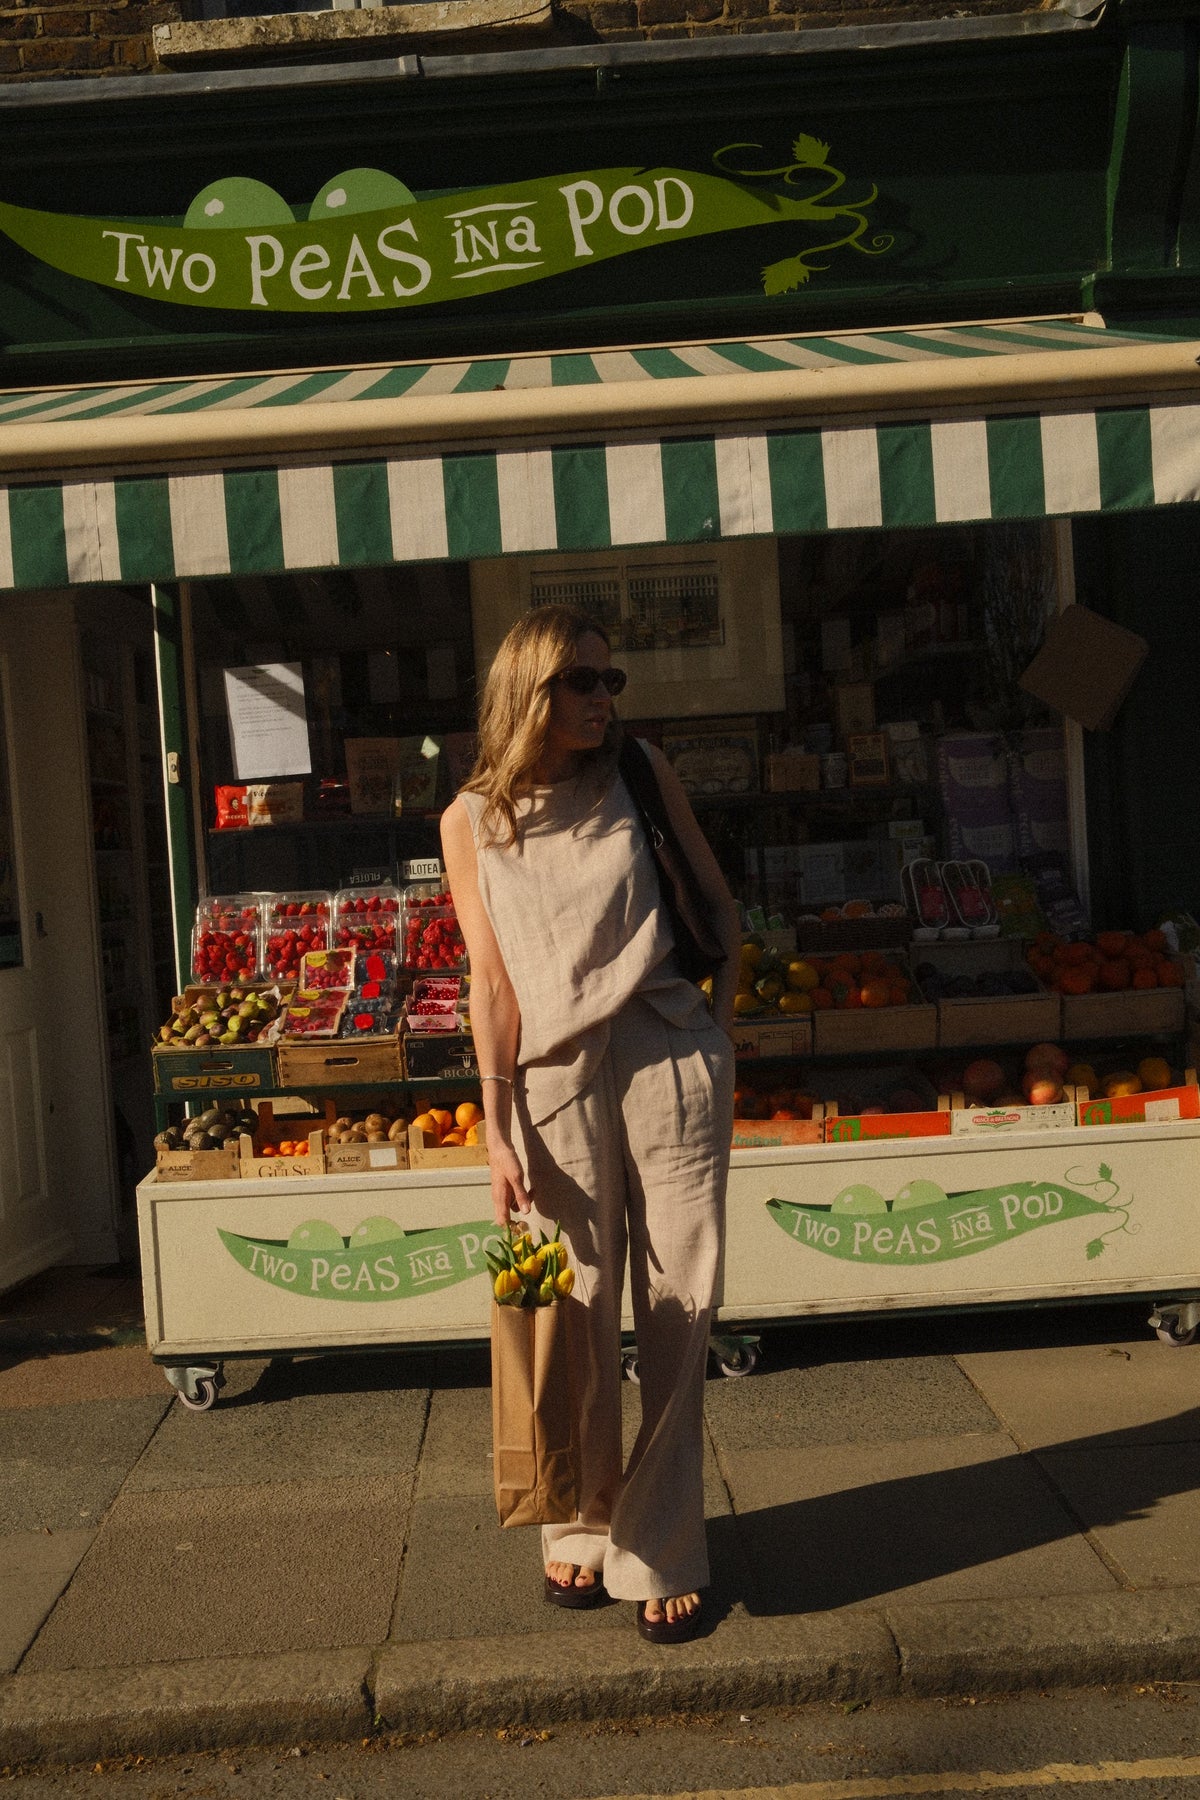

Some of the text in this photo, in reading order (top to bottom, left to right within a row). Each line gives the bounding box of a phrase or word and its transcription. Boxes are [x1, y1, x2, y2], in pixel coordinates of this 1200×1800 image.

[558, 177, 694, 257] POD
[404, 863, 439, 875] FILOTEA
[177, 1073, 256, 1088] SISO
[998, 1190, 1065, 1231] POD
[458, 1232, 505, 1270] PO
